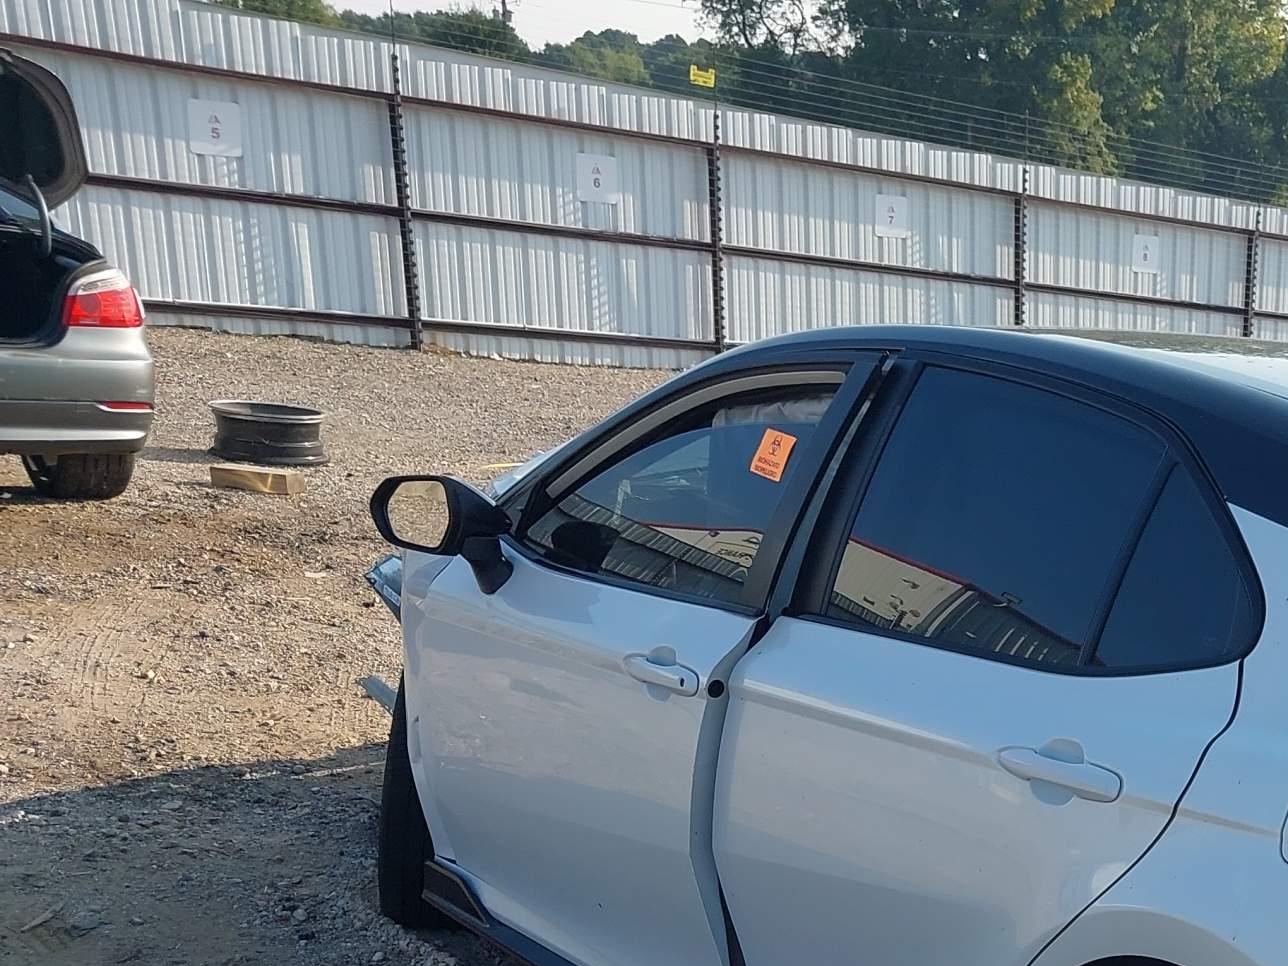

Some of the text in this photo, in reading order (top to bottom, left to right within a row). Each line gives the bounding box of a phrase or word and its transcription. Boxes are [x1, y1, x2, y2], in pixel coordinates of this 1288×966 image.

[210, 127, 221, 139] 5
[593, 177, 601, 189] 6
[888, 215, 895, 225] 7
